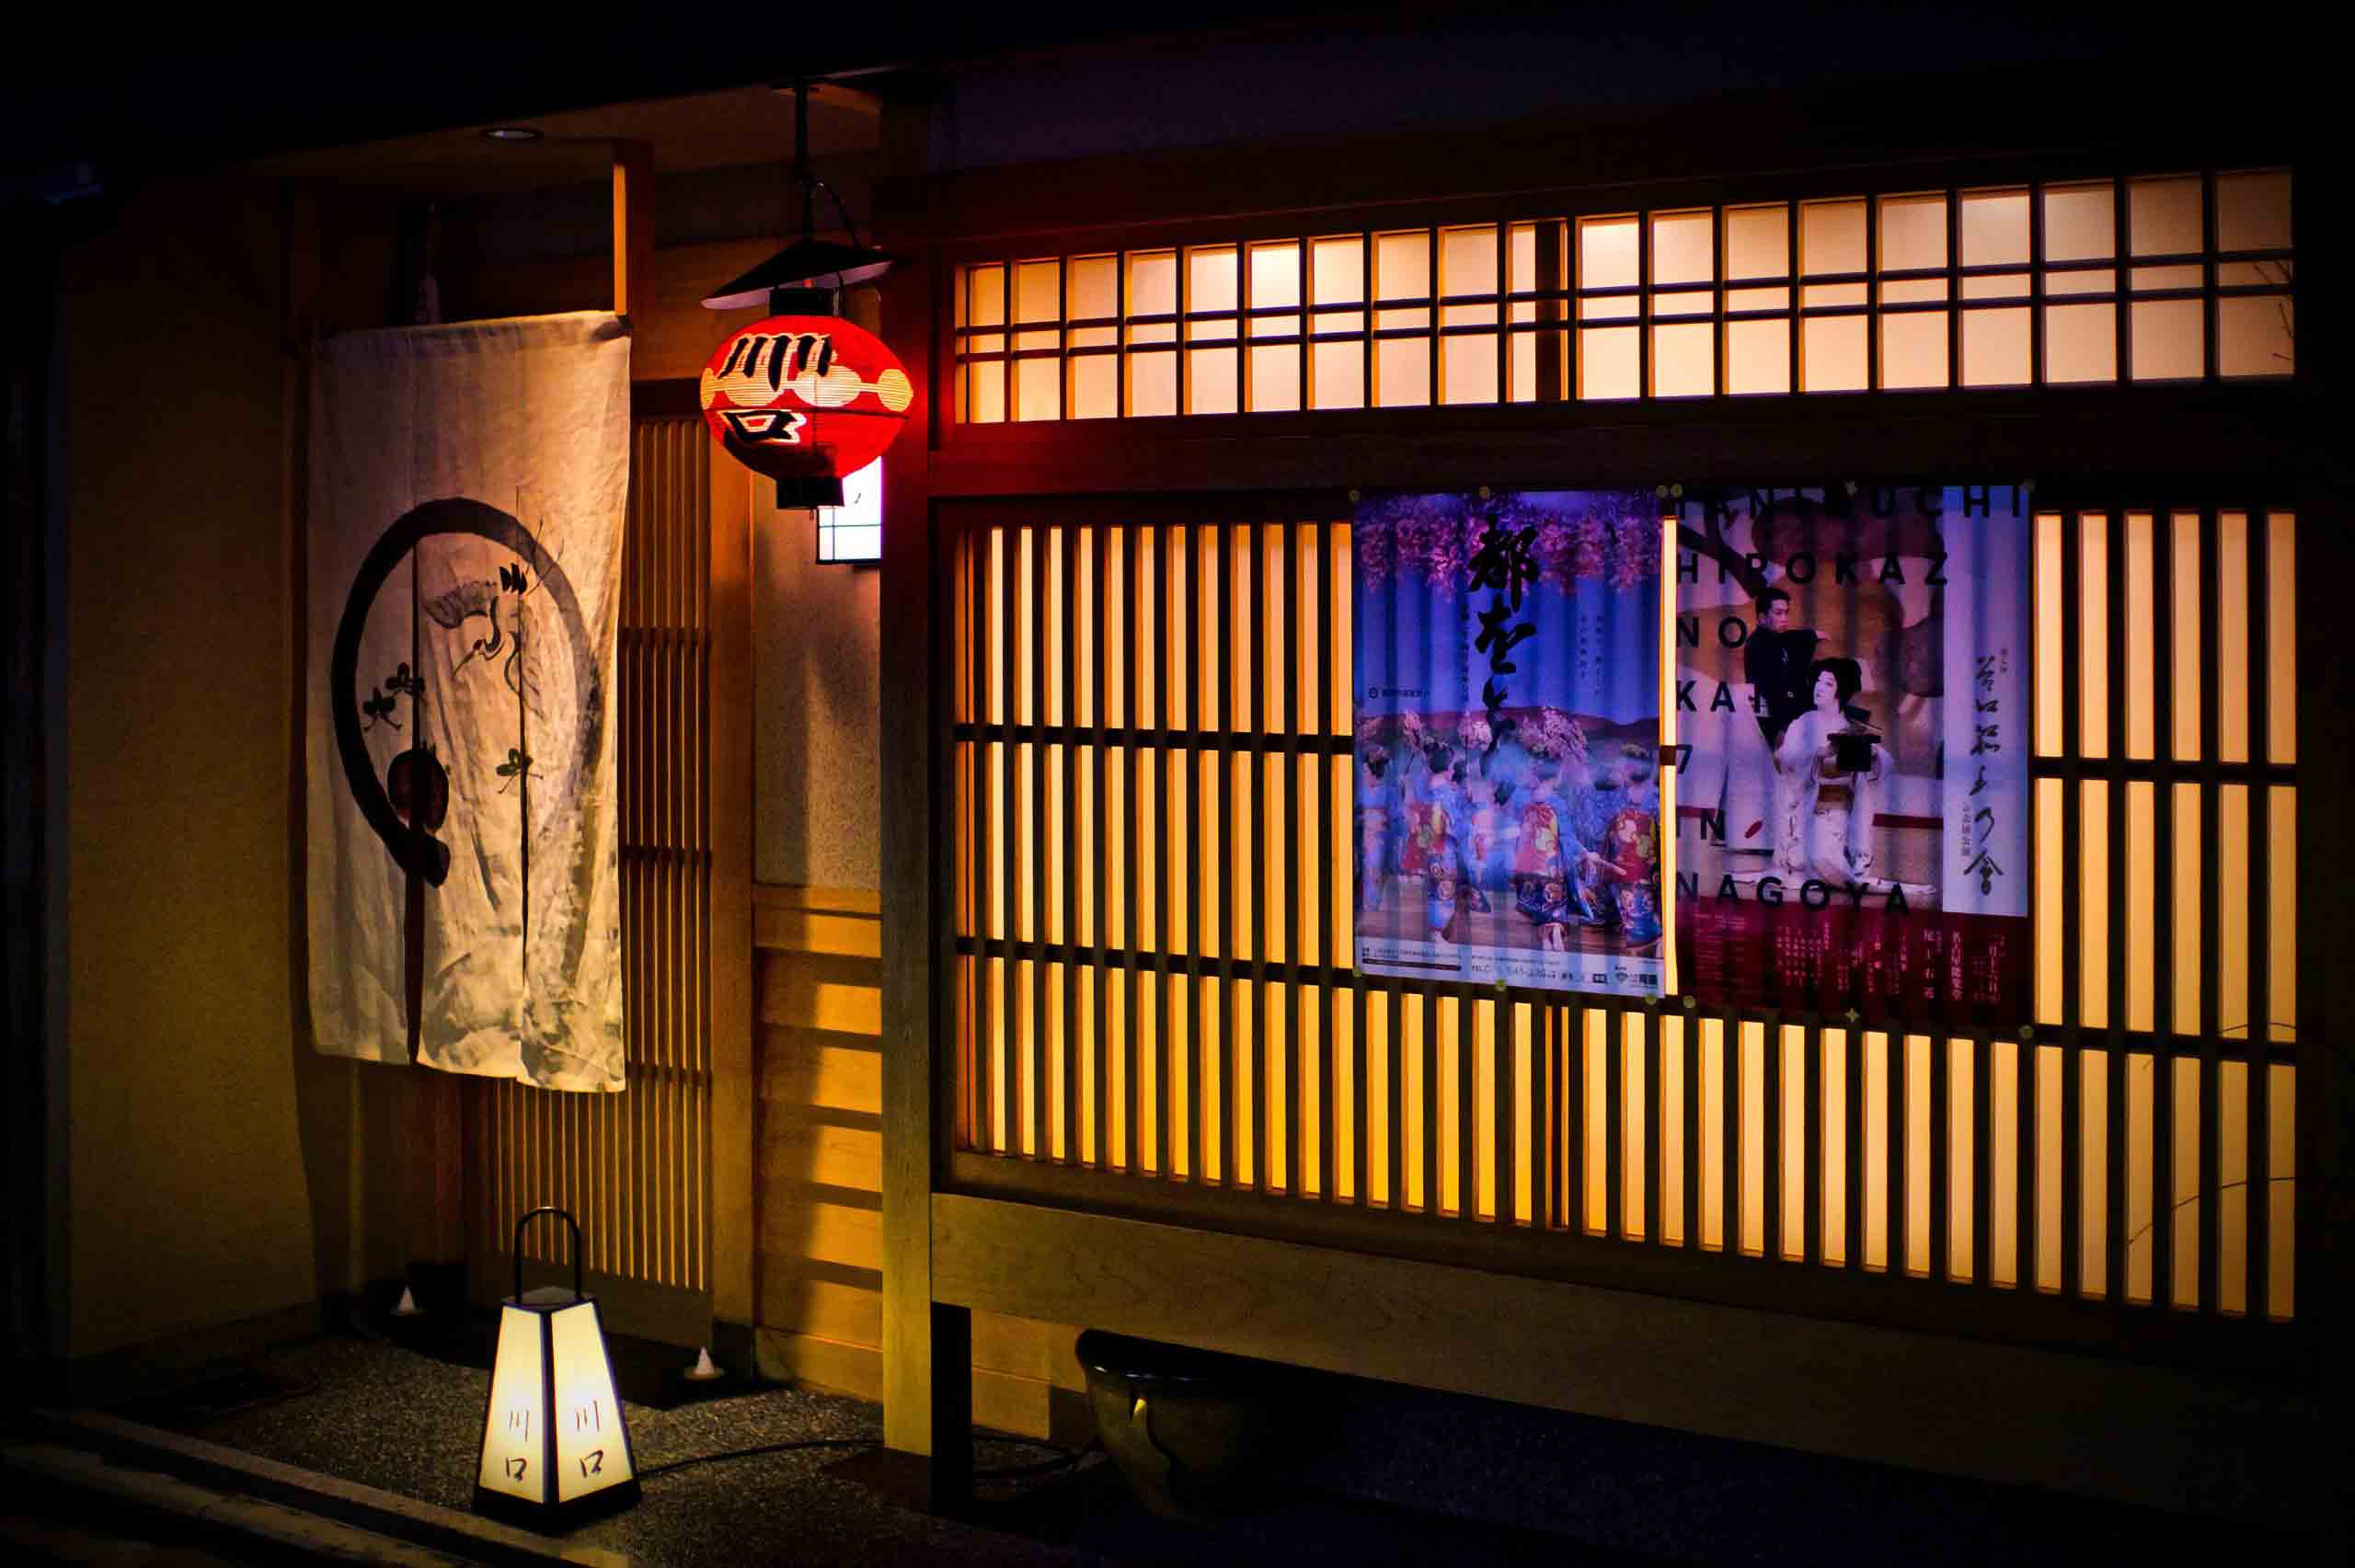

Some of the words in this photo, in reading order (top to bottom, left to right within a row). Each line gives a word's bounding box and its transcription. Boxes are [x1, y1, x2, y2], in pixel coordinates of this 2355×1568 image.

[1676, 615, 1748, 648] NO
[1676, 743, 1694, 775] 7
[1676, 808, 1727, 840] IN
[1676, 871, 1910, 913] NAGOYA
[506, 1409, 531, 1482] 川口
[574, 1399, 604, 1480] 川口
